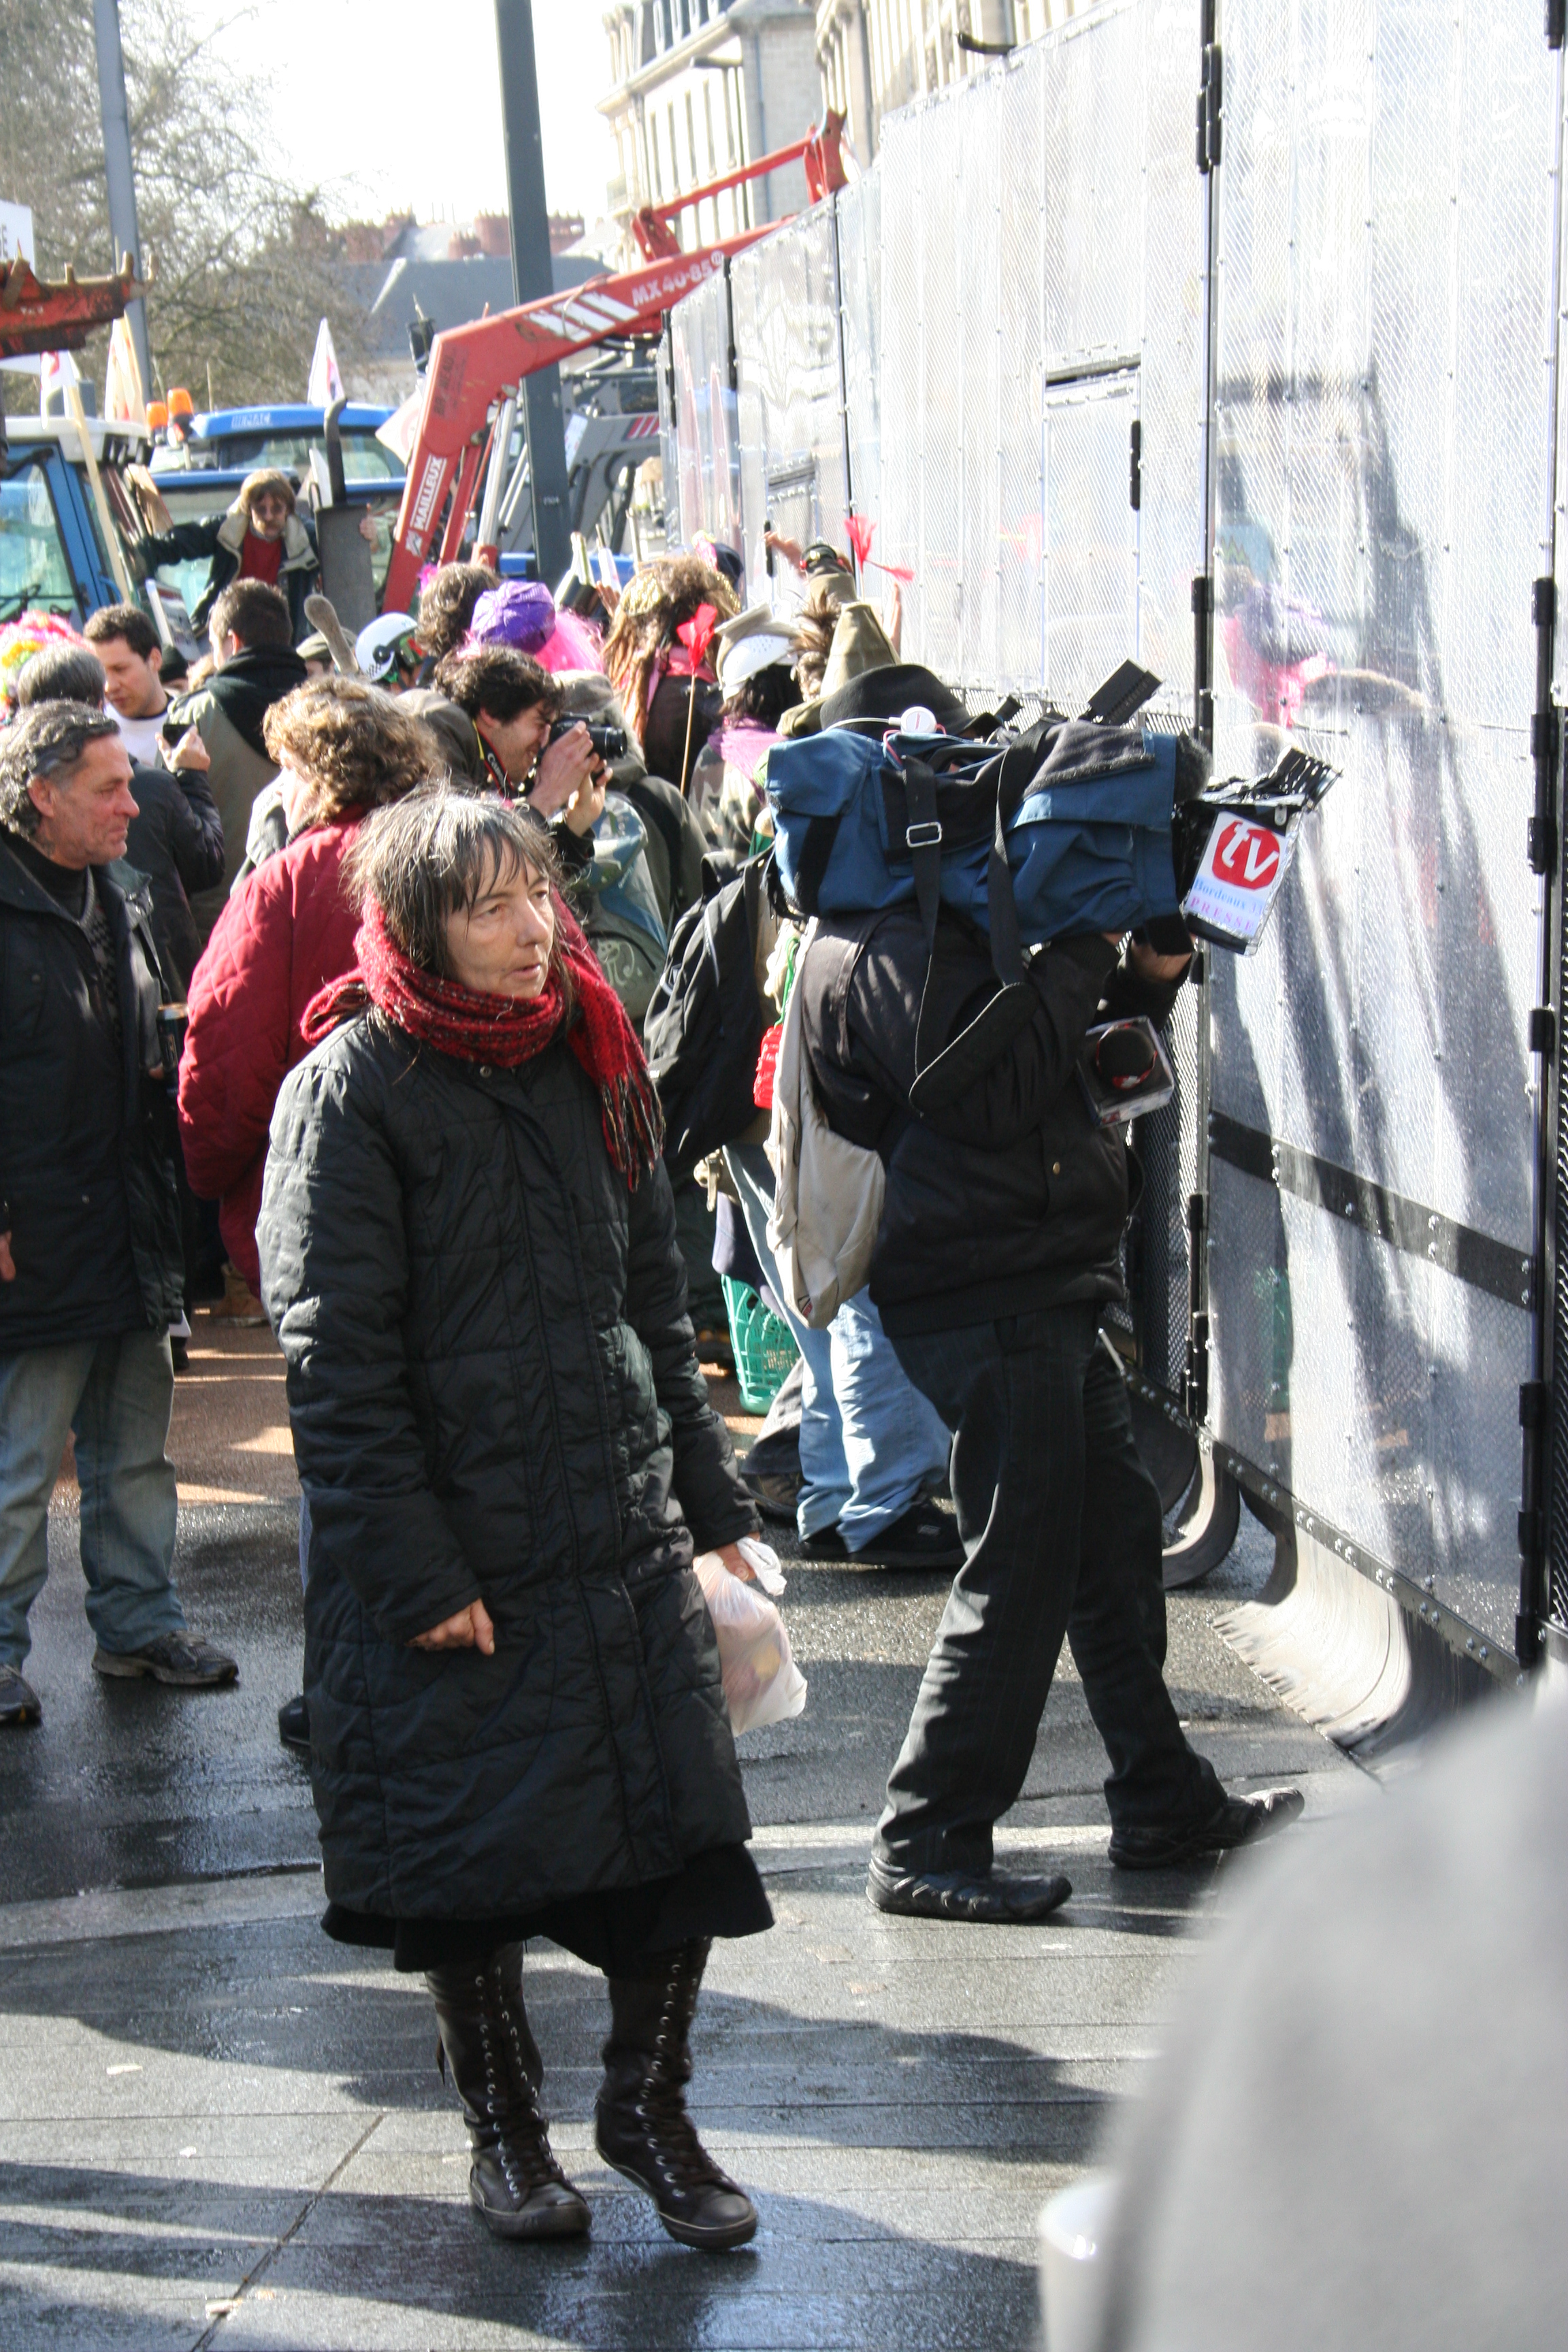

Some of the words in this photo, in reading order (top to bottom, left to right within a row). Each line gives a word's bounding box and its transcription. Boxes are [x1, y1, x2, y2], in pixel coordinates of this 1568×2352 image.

[632, 279, 662, 306] MX
[413, 455, 443, 531] MAILLEUX
[1222, 822, 1279, 882] tv
[1194, 877, 1246, 910] Bordeaux
[1190, 896, 1255, 932] PRESSE
